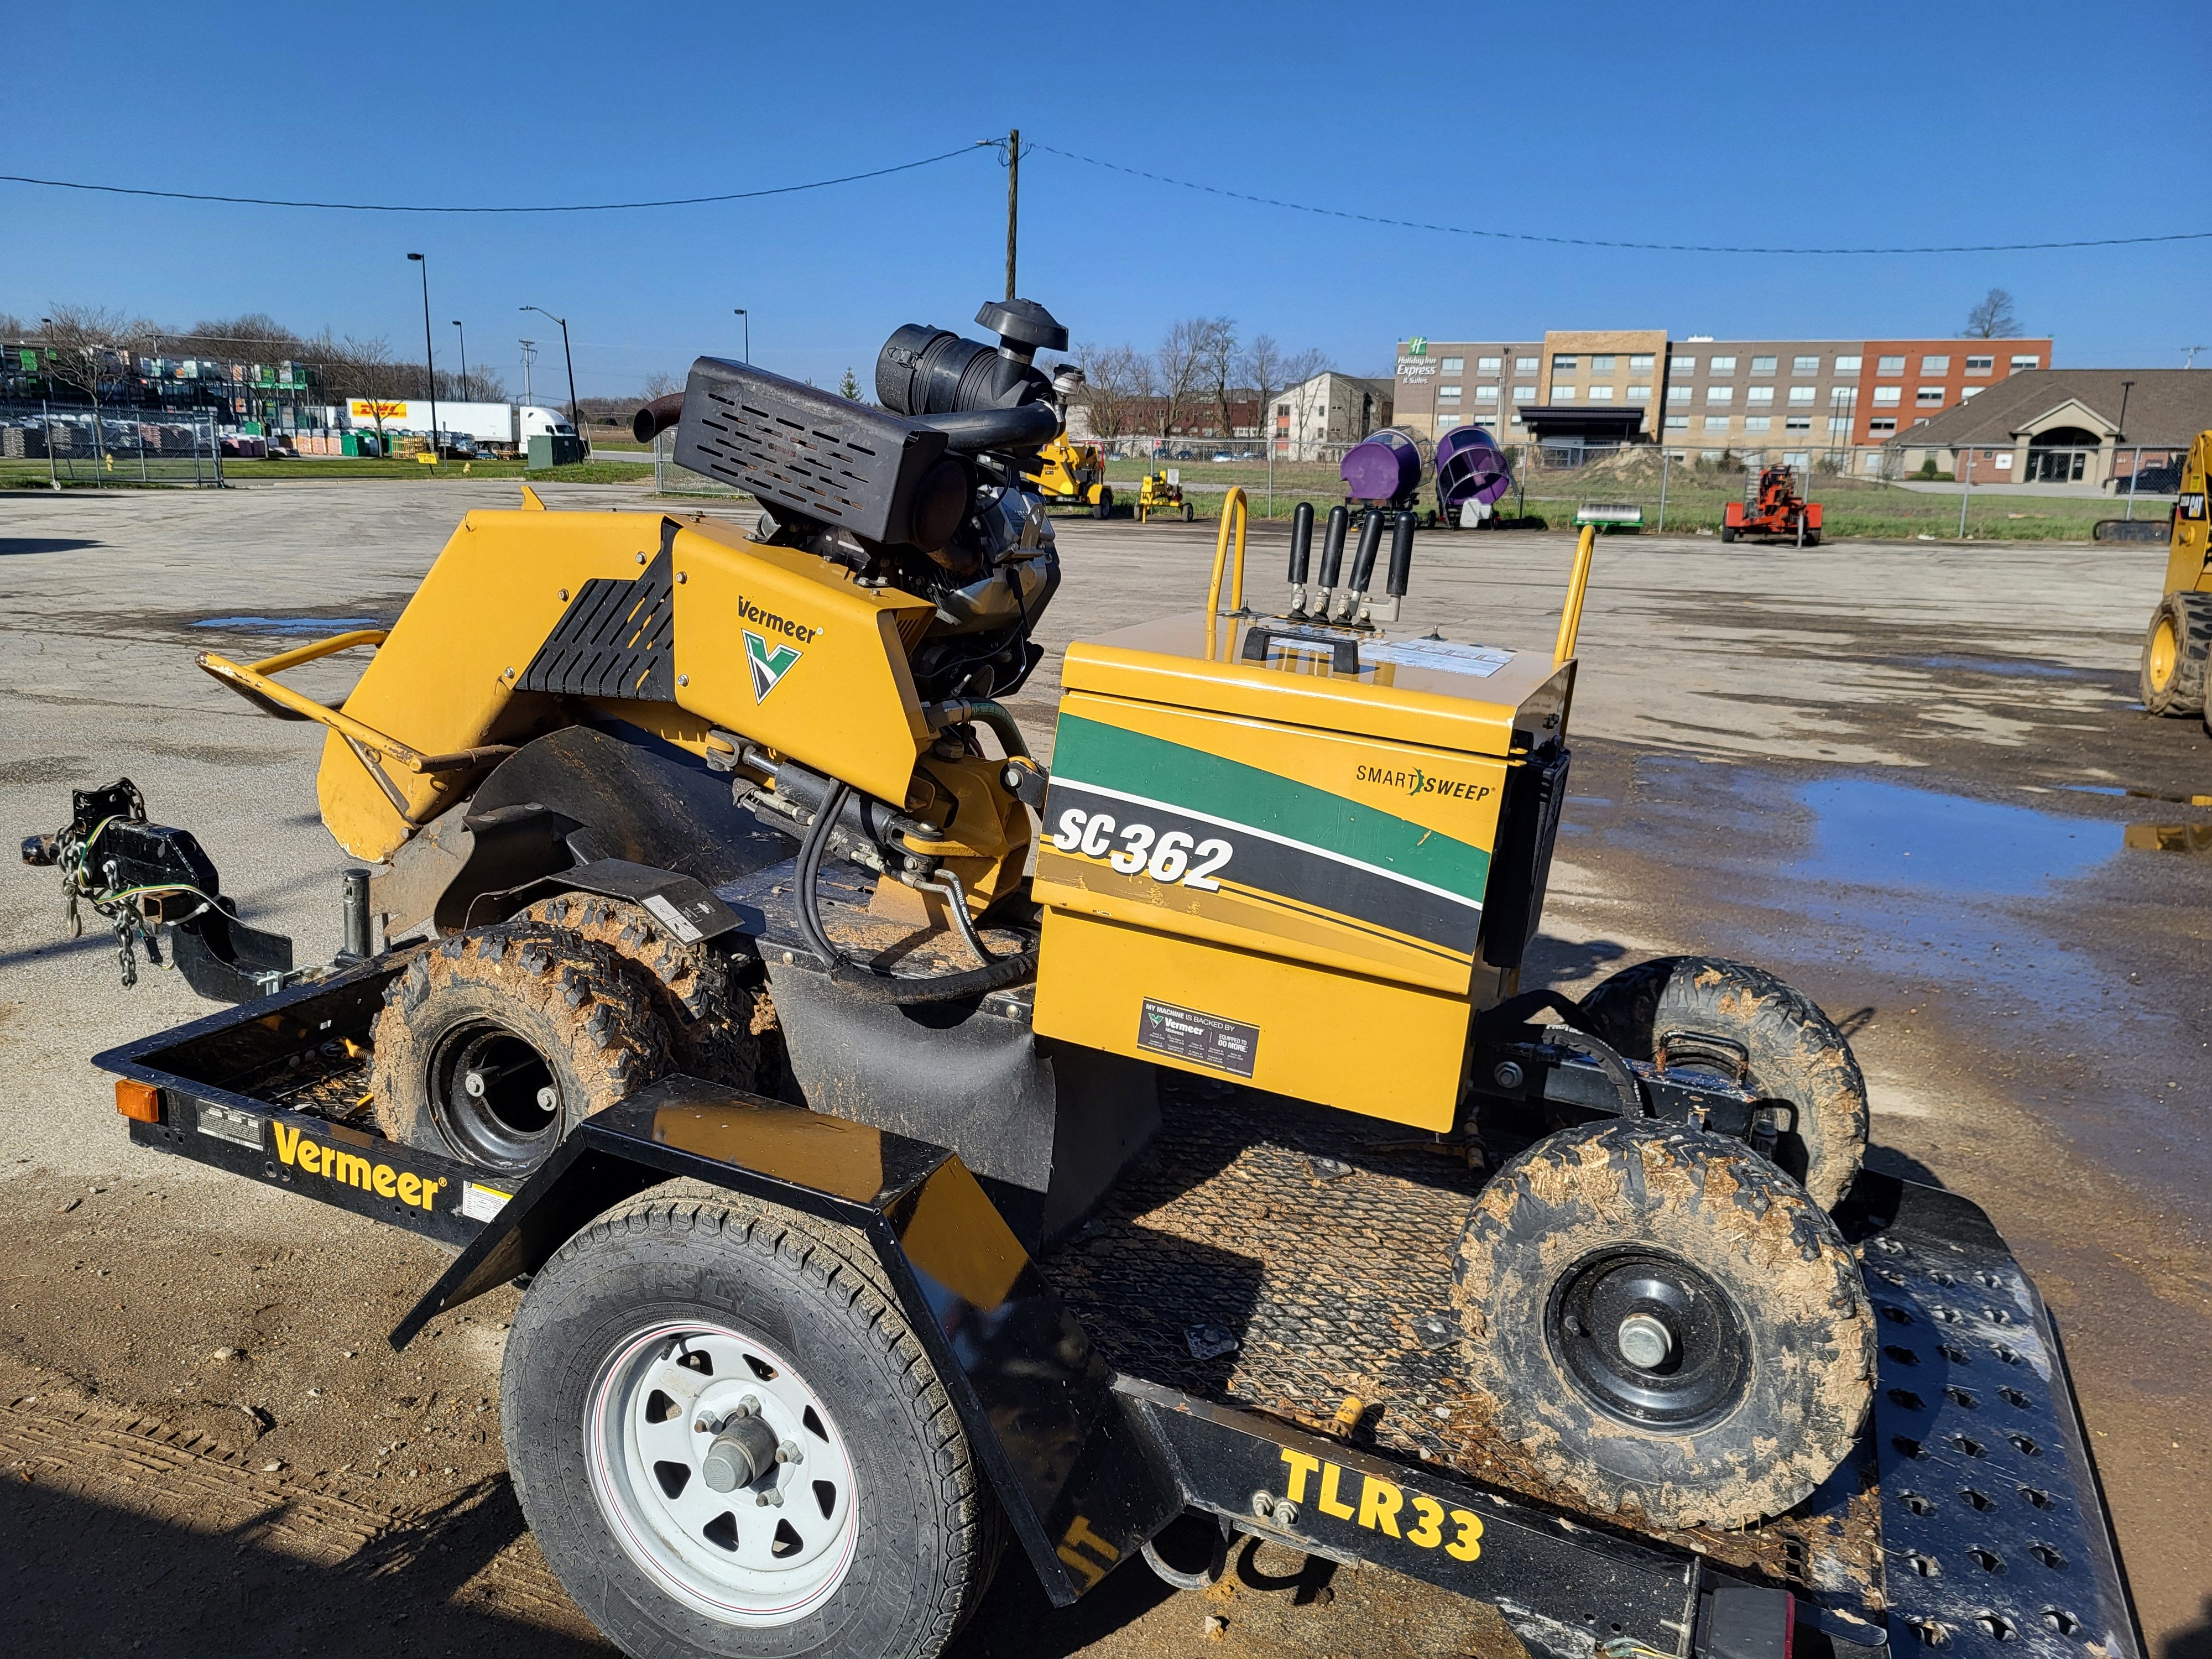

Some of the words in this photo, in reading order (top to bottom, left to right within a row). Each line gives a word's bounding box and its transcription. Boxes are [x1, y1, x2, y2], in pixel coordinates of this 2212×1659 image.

[1397, 356, 1424, 366] Holiday
[1425, 356, 1437, 364] Inn
[1397, 364, 1437, 377] Express
[359, 404, 399, 415] DHL
[1357, 765, 1417, 789] SMART
[1423, 778, 1490, 801] SWEEP
[1052, 808, 1234, 891] SC362
[953, 880, 965, 905] DIEHARD
[1146, 1003, 1156, 1011] MY
[1156, 1006, 1185, 1019] MACHINE
[1193, 1016, 1223, 1029] BACKED
[1224, 1024, 1235, 1032] BY
[1165, 1017, 1204, 1036] Vermeer
[1165, 1027, 1185, 1036] Midwest
[1218, 1034, 1240, 1044] EQUIPPED
[1218, 1039, 1227, 1047] DO
[1280, 1448, 1485, 1562] TLR33
